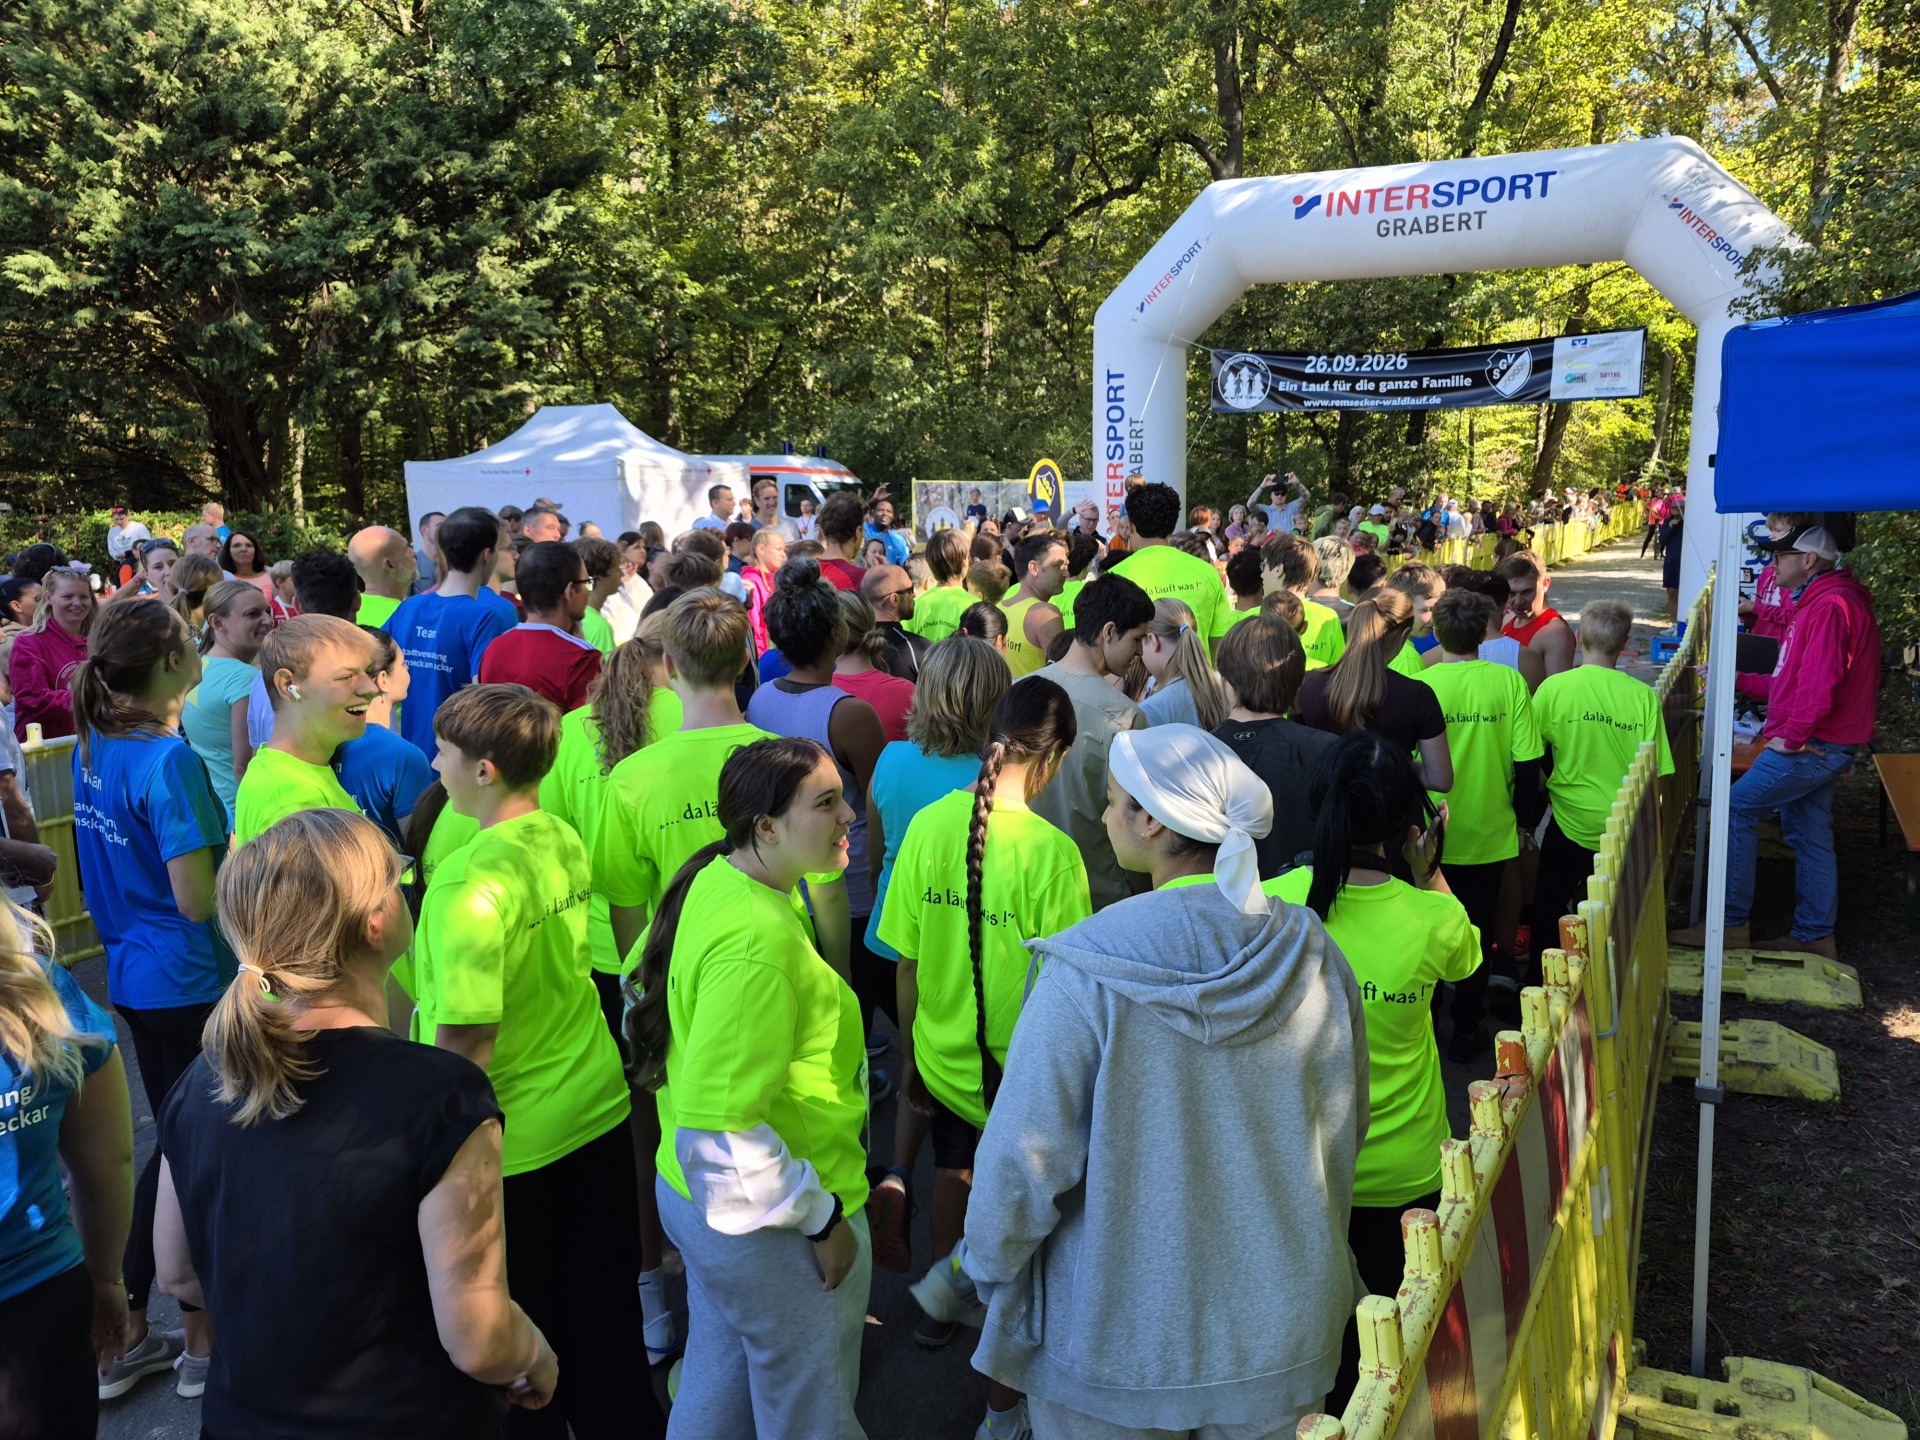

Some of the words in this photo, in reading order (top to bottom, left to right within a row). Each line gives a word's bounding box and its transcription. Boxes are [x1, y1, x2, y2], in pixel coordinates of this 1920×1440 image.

[1325, 170, 1557, 218] INTERSPORT
[1376, 210, 1488, 238] GRABERT
[1677, 206, 1748, 270] INTERSPOR
[1144, 240, 1202, 305] INTERSPORT
[1304, 353, 1409, 374] 26.09.2026
[1492, 353, 1516, 380] SGV
[1278, 382, 1298, 392] Ein
[1301, 380, 1330, 392] Lauf
[1332, 380, 1351, 391] für
[1355, 379, 1376, 391] die
[1379, 380, 1418, 393] ganze
[1422, 375, 1473, 389] Familie
[1303, 395, 1442, 408] www.remsecker-waldlauf.de
[1457, 711, 1480, 724] läuft
[1482, 714, 1497, 723] was
[1583, 710, 1595, 722] da
[1614, 721, 1633, 732] was
[683, 802, 704, 820] da
[1383, 990, 1418, 1004] was
